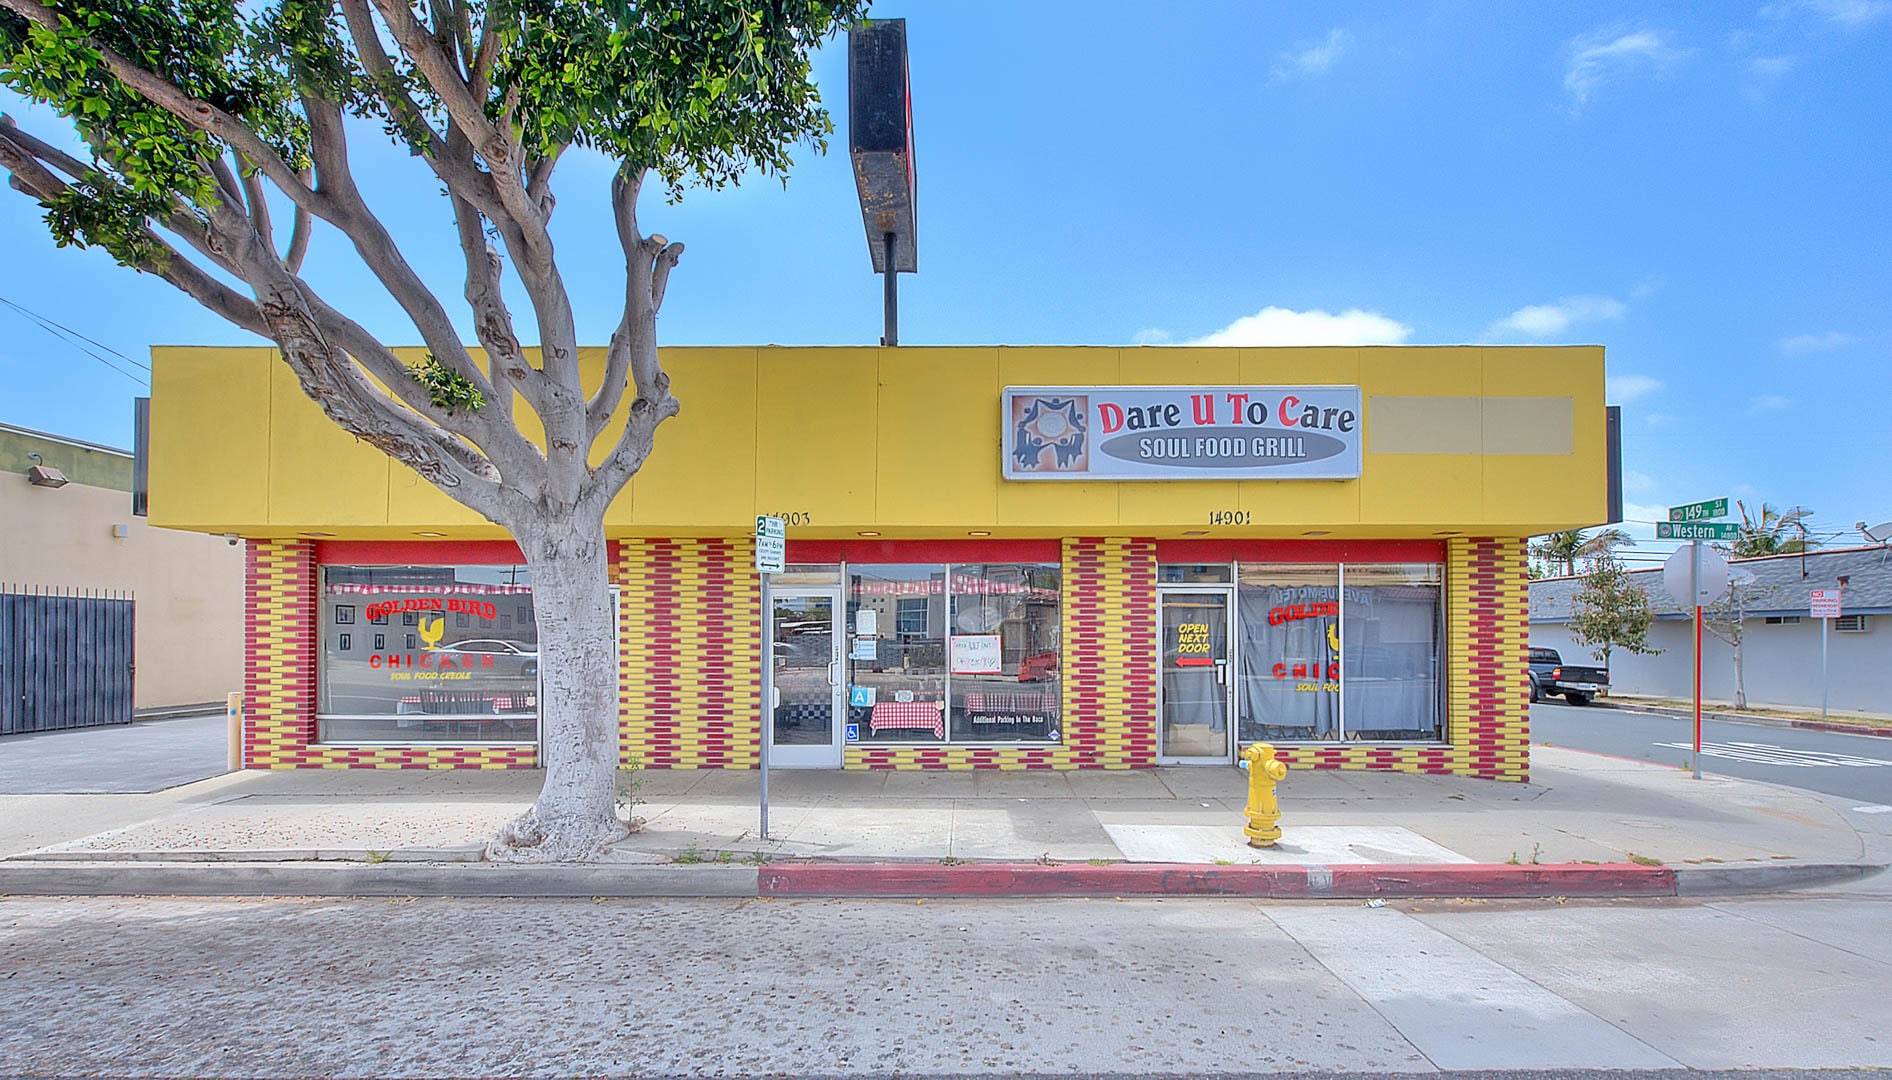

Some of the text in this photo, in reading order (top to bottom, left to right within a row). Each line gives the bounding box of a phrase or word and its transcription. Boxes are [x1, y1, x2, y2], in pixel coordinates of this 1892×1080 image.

[1097, 393, 1355, 434] Dare U To Care
[1139, 437, 1306, 459] SOUL FOOD GRILL
[1210, 510, 1251, 525] 14901
[758, 518, 765, 533] 2
[765, 527, 784, 536] PARKING
[1672, 523, 1715, 538] Western
[366, 597, 497, 621] GOLDEN BIRD
[1178, 623, 1209, 634] OPEN
[1178, 633, 1210, 643] NEXT
[1178, 643, 1211, 654] DOOR
[369, 654, 494, 669] CHICKEN
[414, 671, 437, 680] FOOD
[439, 671, 472, 680] CREOLE
[1295, 683, 1319, 692] SOUL
[854, 691, 865, 703] A
[973, 715, 996, 724] Additional
[997, 715, 1015, 725] Parking
[1022, 715, 1031, 723] The
